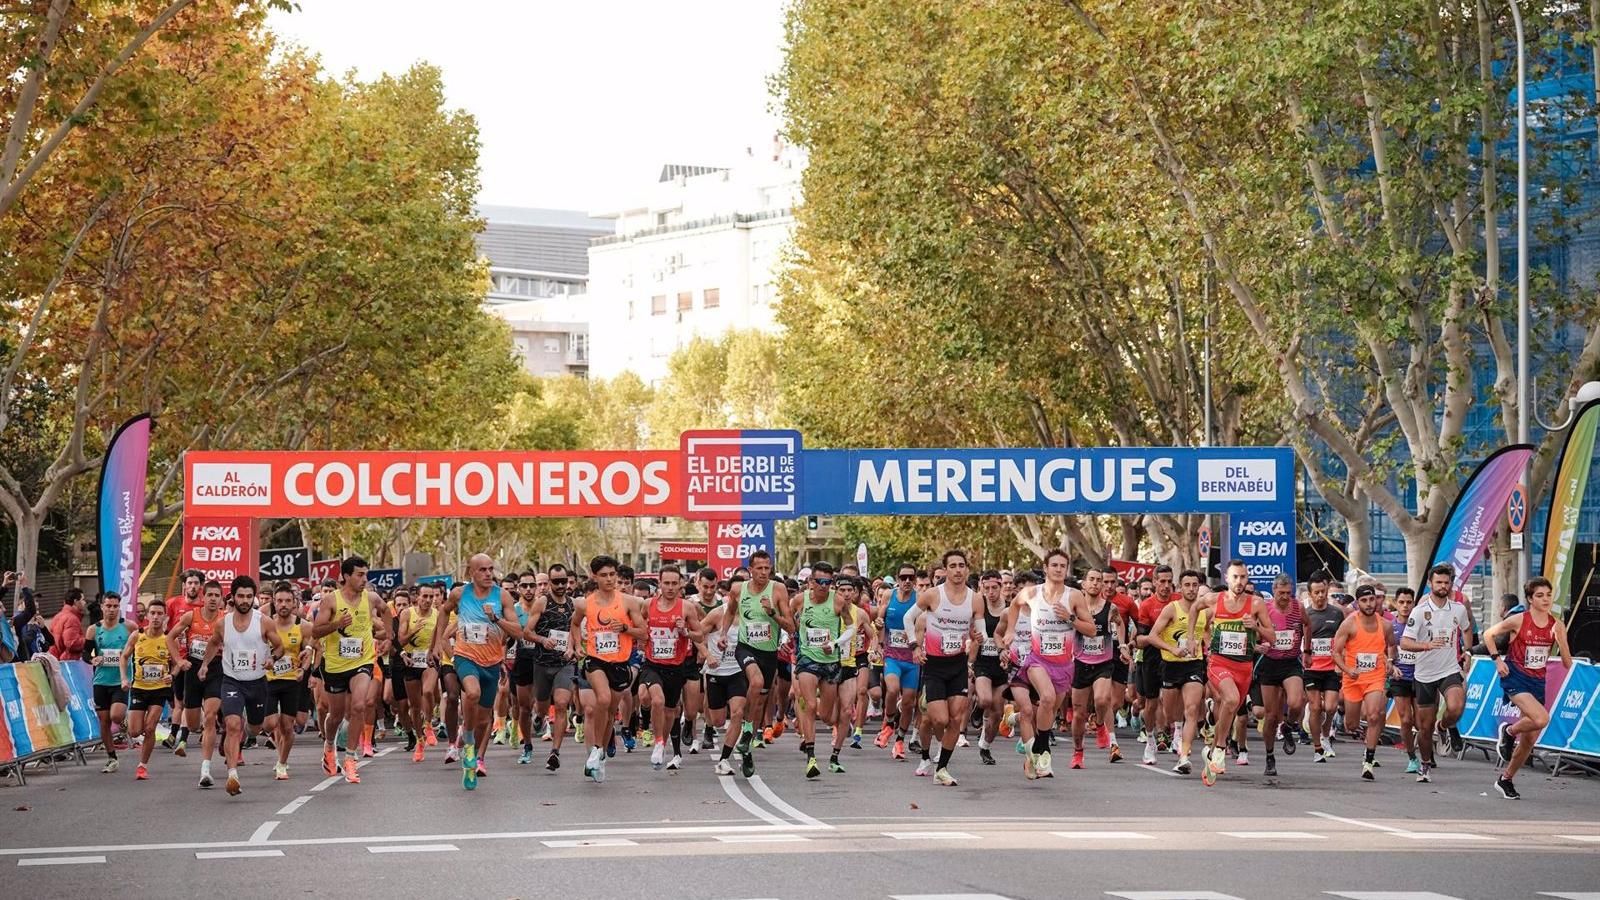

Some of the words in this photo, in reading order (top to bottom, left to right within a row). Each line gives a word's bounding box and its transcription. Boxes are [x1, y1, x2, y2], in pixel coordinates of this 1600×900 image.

[688, 456, 710, 474] EL
[716, 456, 775, 474] DERBI
[780, 456, 794, 466] DE
[224, 471, 241, 483] AL
[853, 457, 1177, 503] MERENGUES
[1225, 467, 1250, 479] DEL
[196, 483, 268, 497] CALDERÓN
[283, 461, 671, 506] COLCHONEROS
[688, 475, 795, 493] AFICIONES
[1201, 478, 1274, 493] BERNABÉU
[192, 526, 240, 540] HOKA
[717, 524, 765, 538] HOKA
[1238, 521, 1287, 536] HOKA
[1467, 506, 1485, 546] HUMAN
[1458, 526, 1469, 544] FLY
[211, 546, 241, 562] BM
[663, 546, 706, 554] COLCHONEROS
[1257, 541, 1287, 556] BM
[342, 646, 361, 654] 3946
[599, 640, 617, 649] 2472
[1044, 642, 1062, 650] 7358
[1224, 641, 1243, 650] 7596
[237, 659, 249, 667] 751
[1530, 655, 1546, 663] 3541
